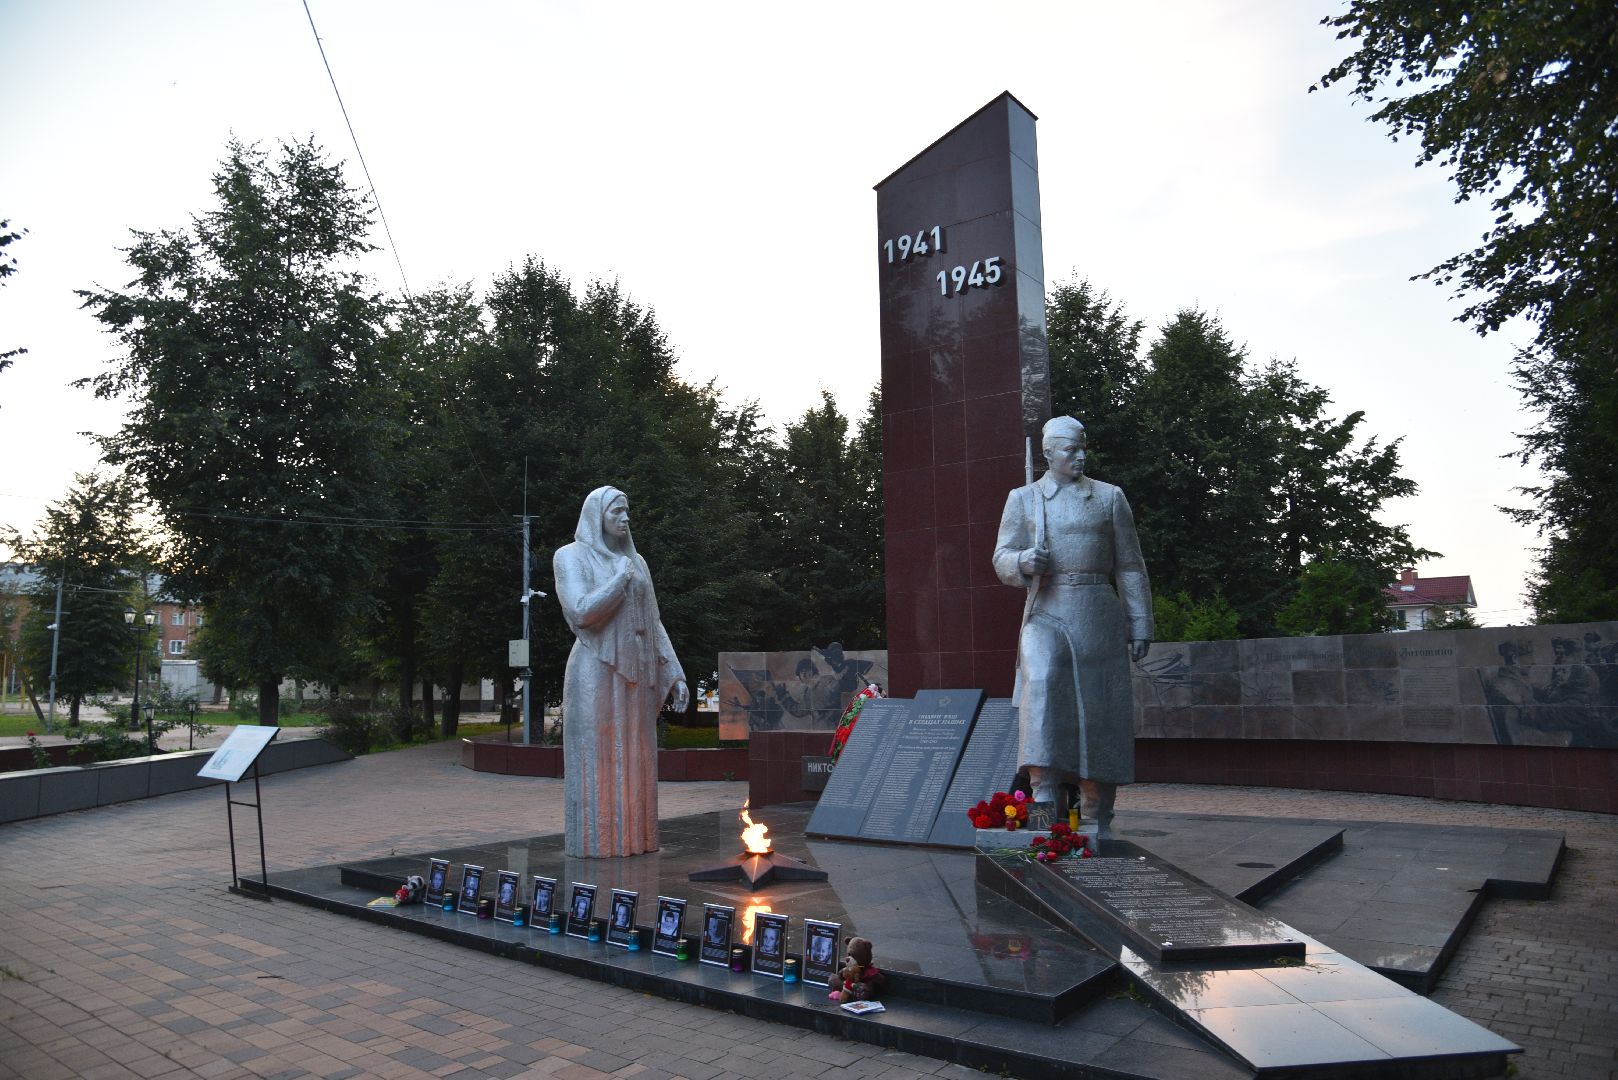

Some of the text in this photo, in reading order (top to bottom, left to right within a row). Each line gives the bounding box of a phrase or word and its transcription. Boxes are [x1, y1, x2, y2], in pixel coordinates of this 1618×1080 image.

[883, 225, 942, 264] 1941
[936, 256, 1002, 296] 1945
[807, 762, 833, 773] НИКТО
